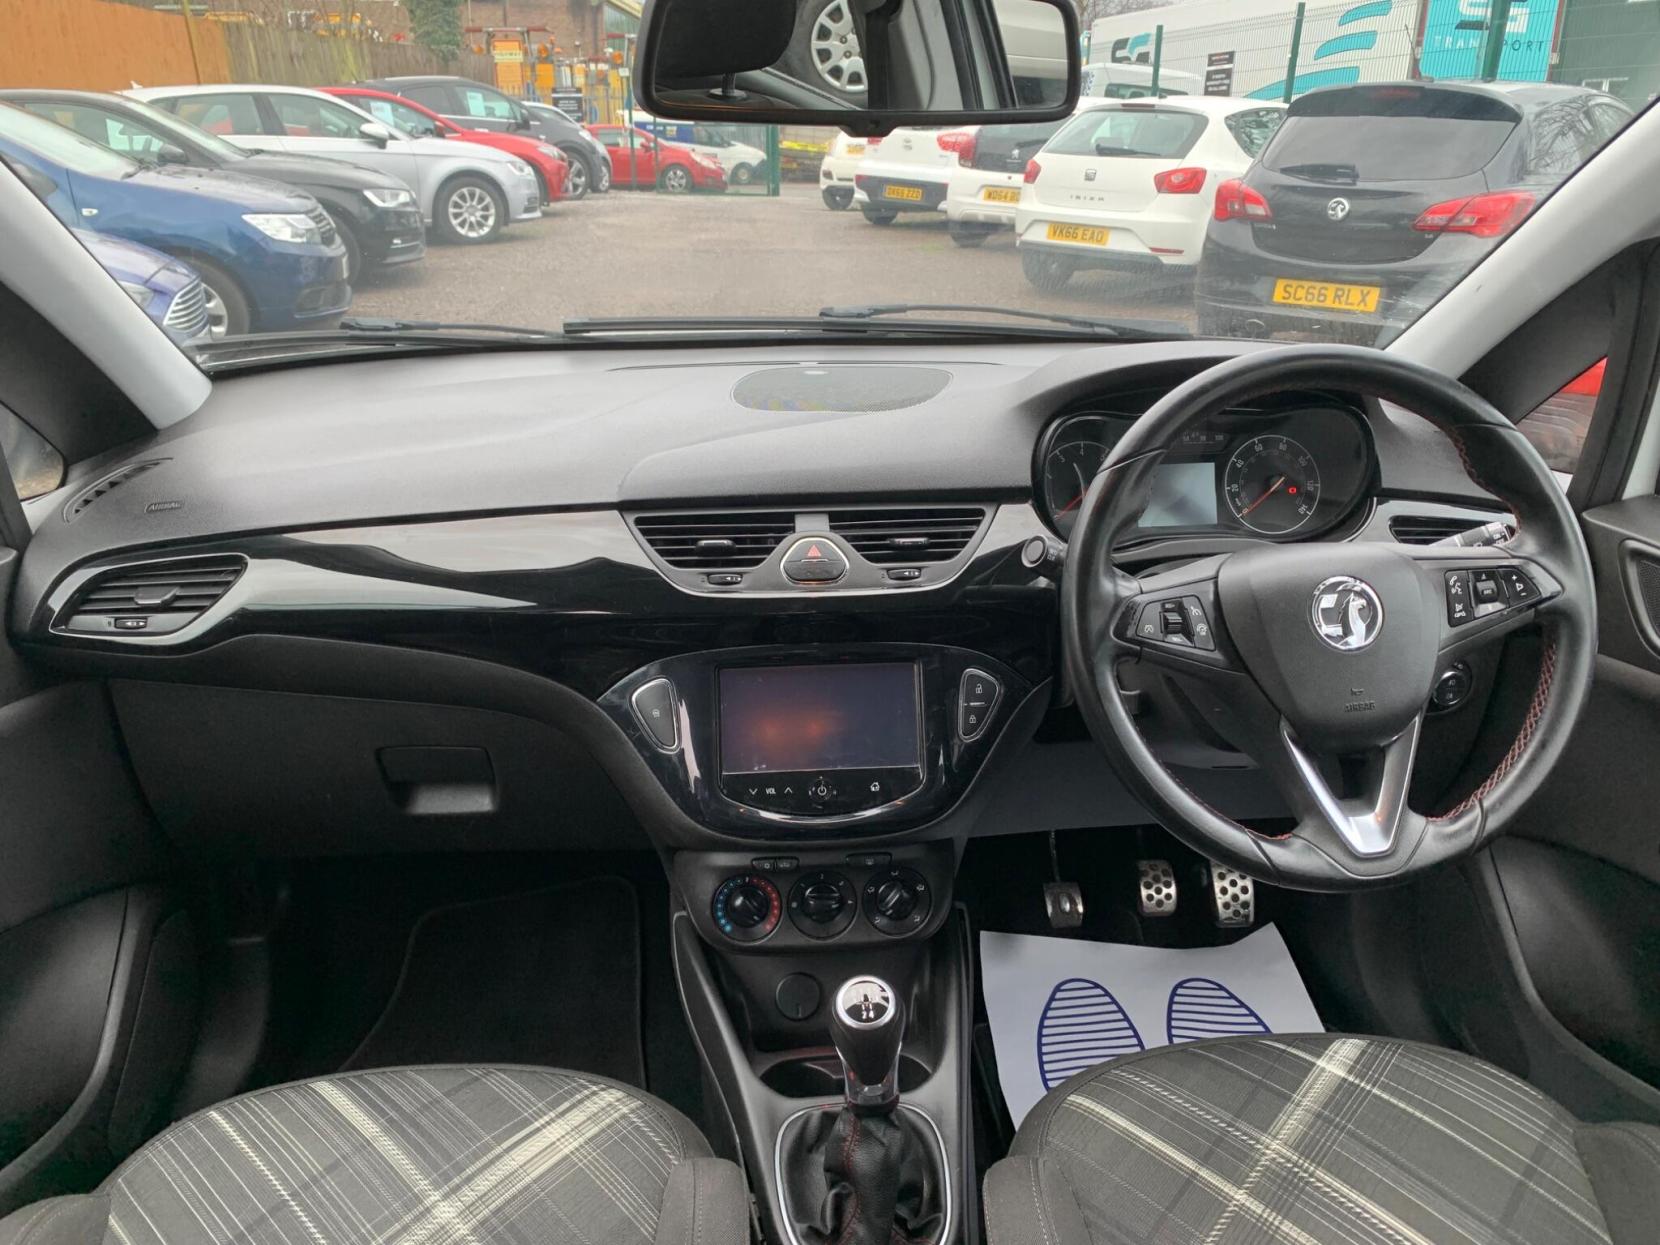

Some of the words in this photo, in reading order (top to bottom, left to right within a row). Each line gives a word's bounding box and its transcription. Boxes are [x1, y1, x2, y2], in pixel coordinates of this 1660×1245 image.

[1434, 36, 1544, 52] TRANPORT
[1052, 224, 1079, 240] VK66
[1282, 284, 1328, 303] SC66
[1333, 287, 1372, 307] RLX
[765, 787, 776, 795] VOL
